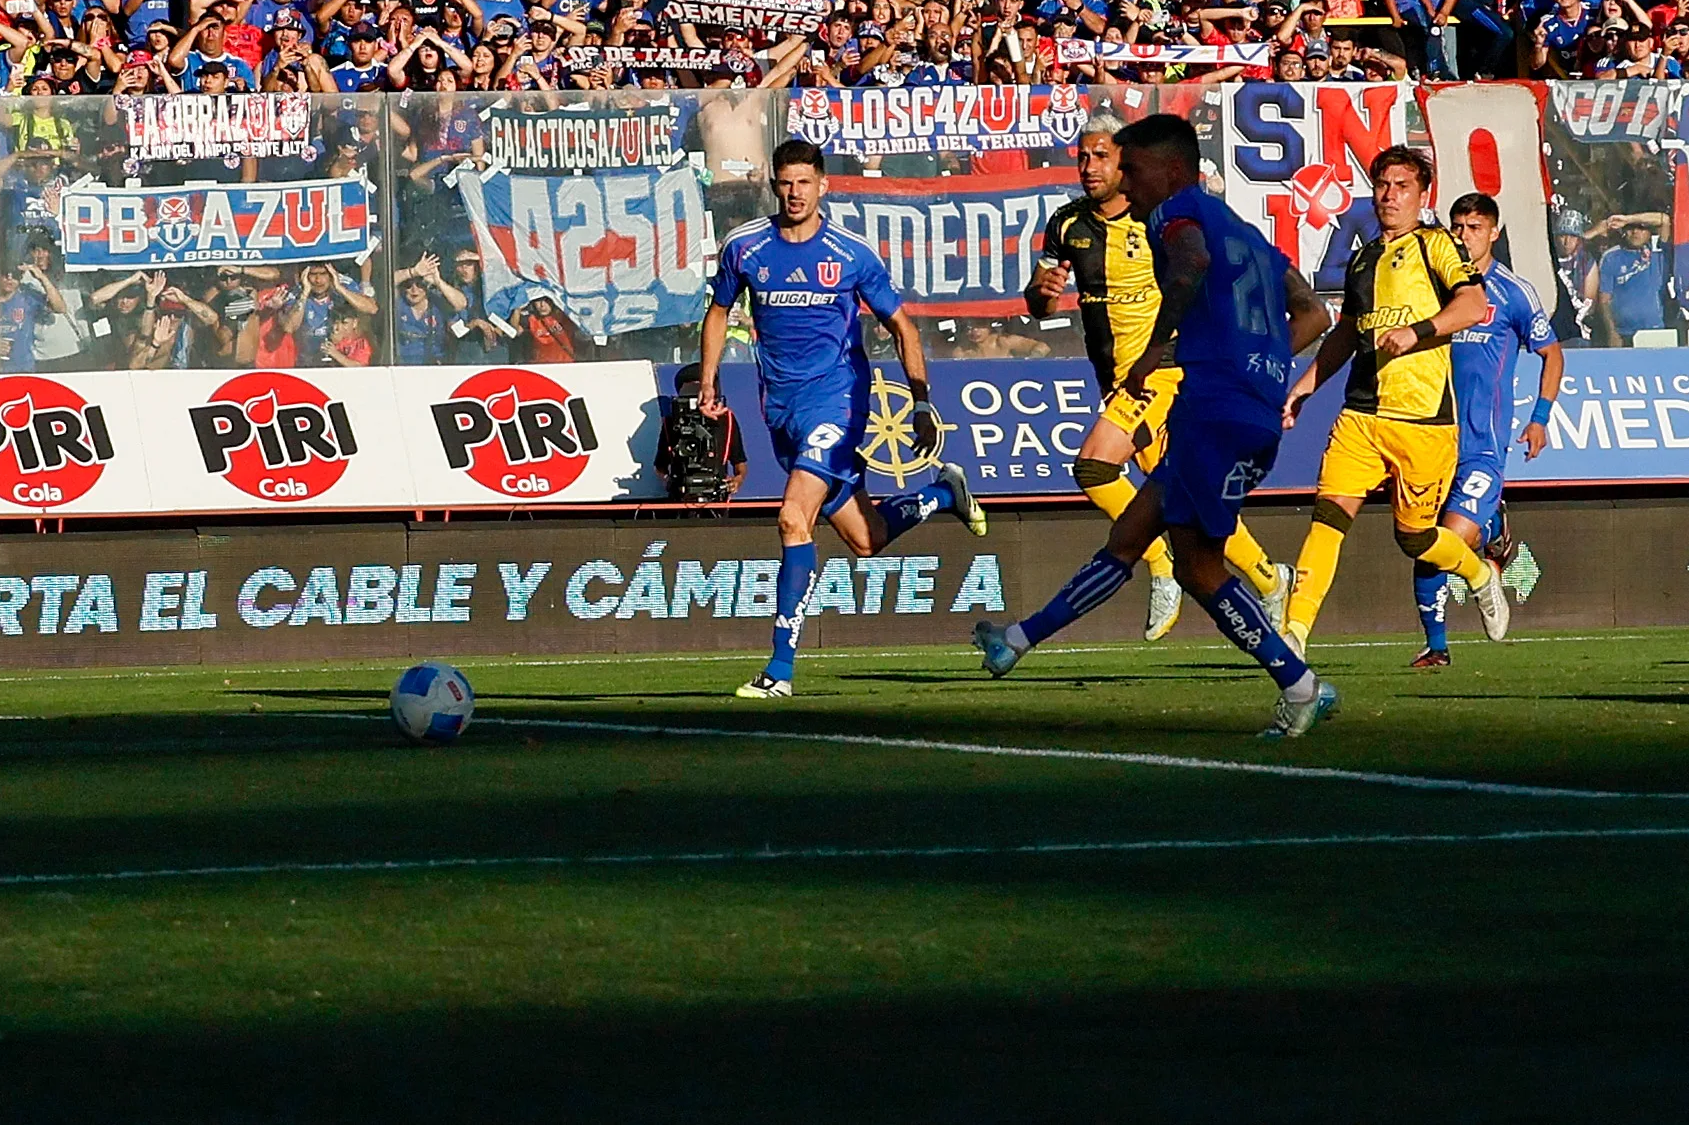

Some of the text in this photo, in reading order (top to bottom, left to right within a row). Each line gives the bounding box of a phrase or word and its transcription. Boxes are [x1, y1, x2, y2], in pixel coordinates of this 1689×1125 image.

[664, 0, 823, 33] DEMEN7ES
[561, 46, 722, 68] LOS DE TALCA
[128, 96, 160, 146] LA
[839, 84, 1041, 135] LOSC4ZUL
[490, 115, 673, 169] GALACTICOSAZULES
[833, 131, 1055, 155] LA BANDA DEL TERROR
[63, 185, 360, 254] PB AZUL
[150, 251, 177, 264] LA
[828, 191, 1070, 298] EMEN7
[961, 380, 1105, 415] OCE
[970, 422, 1086, 457] PAC
[13, 482, 63, 504] Cola
[258, 476, 308, 497] Cola
[501, 474, 550, 494] Cola
[139, 570, 217, 632] EL
[238, 562, 479, 629] CABLE
[497, 561, 552, 622] Y
[564, 540, 941, 621] CÁMBATE
[949, 554, 1007, 613] A
